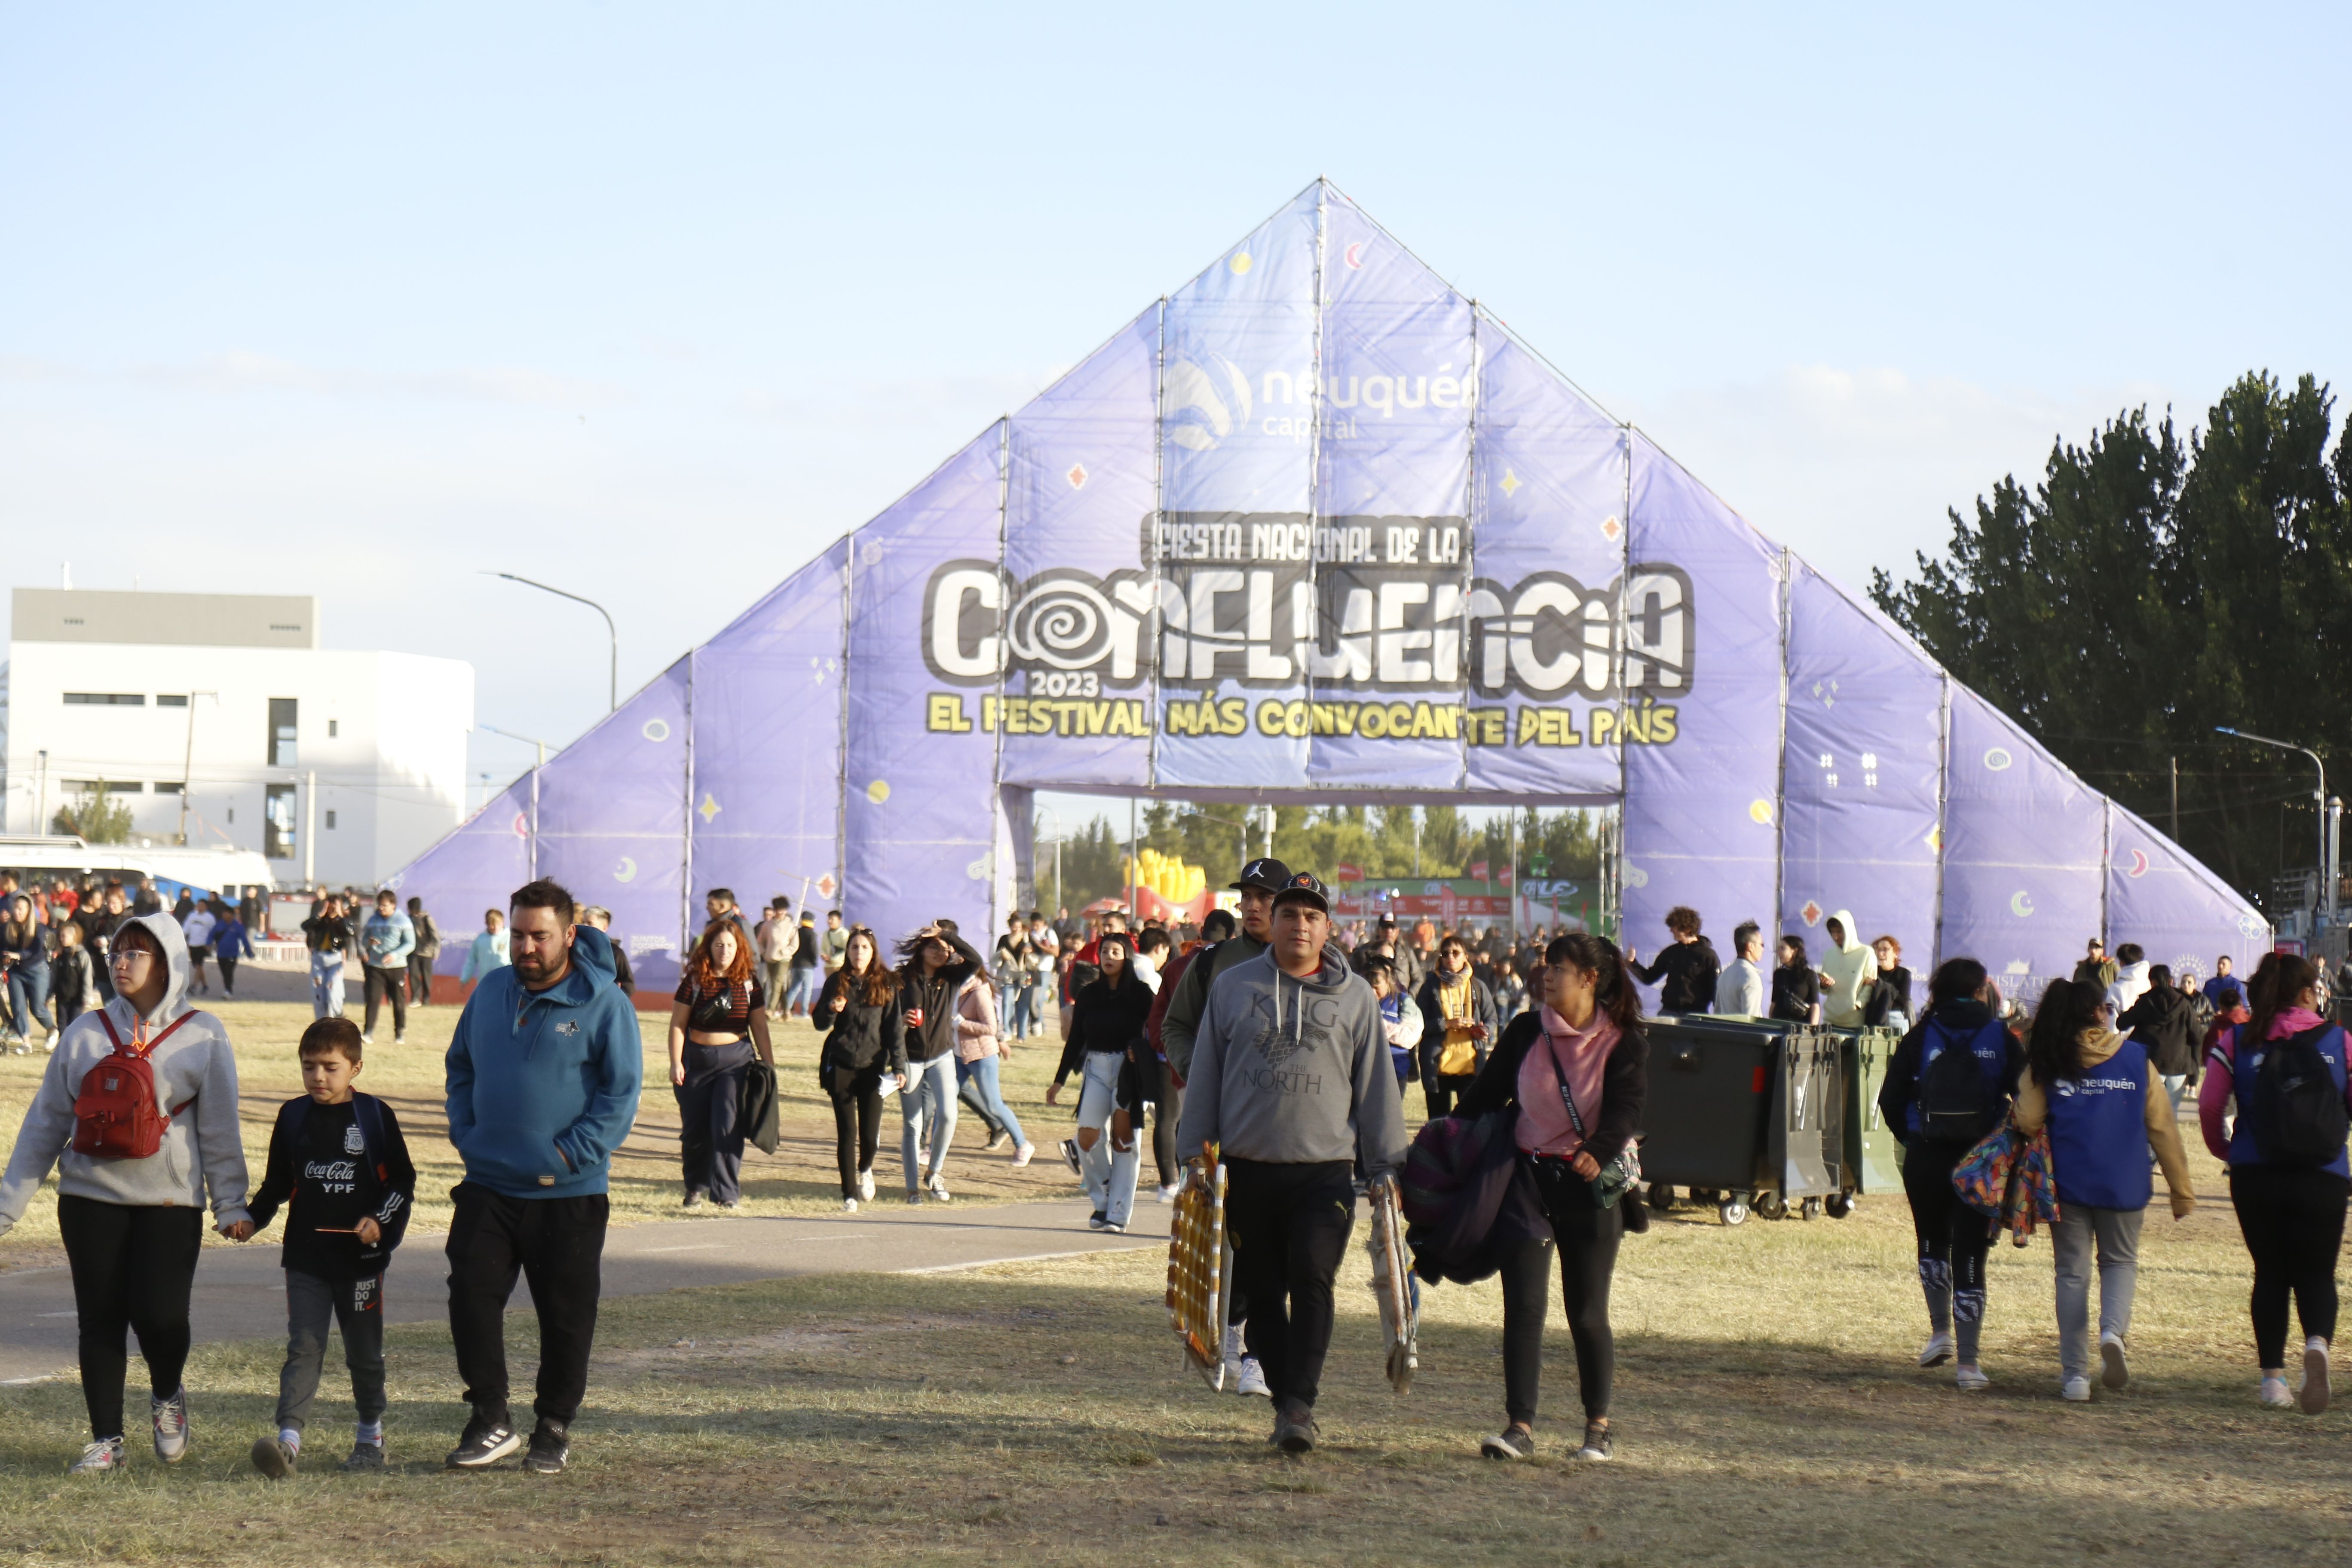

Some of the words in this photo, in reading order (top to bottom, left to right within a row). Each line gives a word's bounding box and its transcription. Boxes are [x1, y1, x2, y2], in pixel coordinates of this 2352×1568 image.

[1263, 416, 1357, 444] captal
[1159, 523, 1242, 560] FIESTA
[1252, 523, 1377, 563] NACIONAL
[1386, 527, 1420, 564] DE
[1428, 527, 1460, 564] LA
[1032, 671, 1099, 697] 2023
[930, 696, 971, 732] EL
[984, 697, 1151, 737] FESTIVAL
[1168, 691, 1247, 736] MÁS
[1260, 701, 1506, 745] CONVOCANTE
[1519, 709, 1580, 745] DEL
[1593, 697, 1676, 744] PAÍS
[1261, 1018, 1271, 1026] IN
[1289, 1064, 1307, 1073] THE
[1243, 1069, 1322, 1095] NORTH
[2081, 1088, 2105, 1096] capital
[1572, 1117, 1582, 1133] REGUL
[322, 1183, 355, 1193] YPF
[355, 1279, 376, 1291] JUST
[355, 1291, 369, 1301] DO
[355, 1302, 365, 1311] IT.
